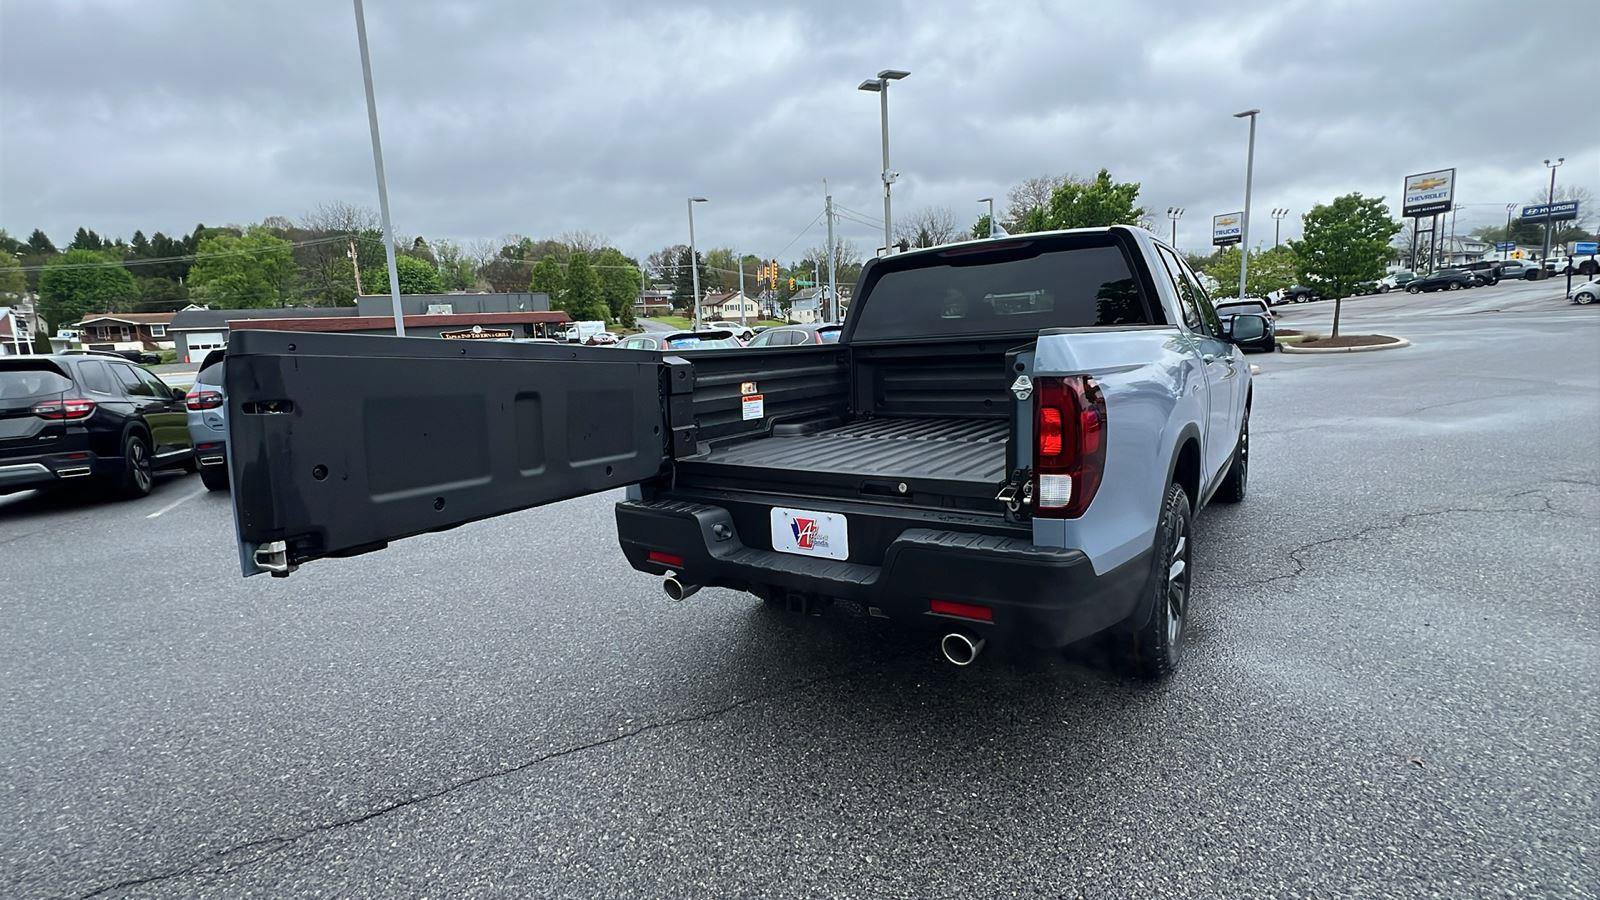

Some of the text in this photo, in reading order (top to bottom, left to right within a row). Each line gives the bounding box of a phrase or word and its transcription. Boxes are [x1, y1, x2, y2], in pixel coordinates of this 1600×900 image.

[1407, 192, 1447, 202] CHEVROLET
[1540, 204, 1575, 213] HYUNDAI
[1215, 228, 1240, 236] TRUCKS
